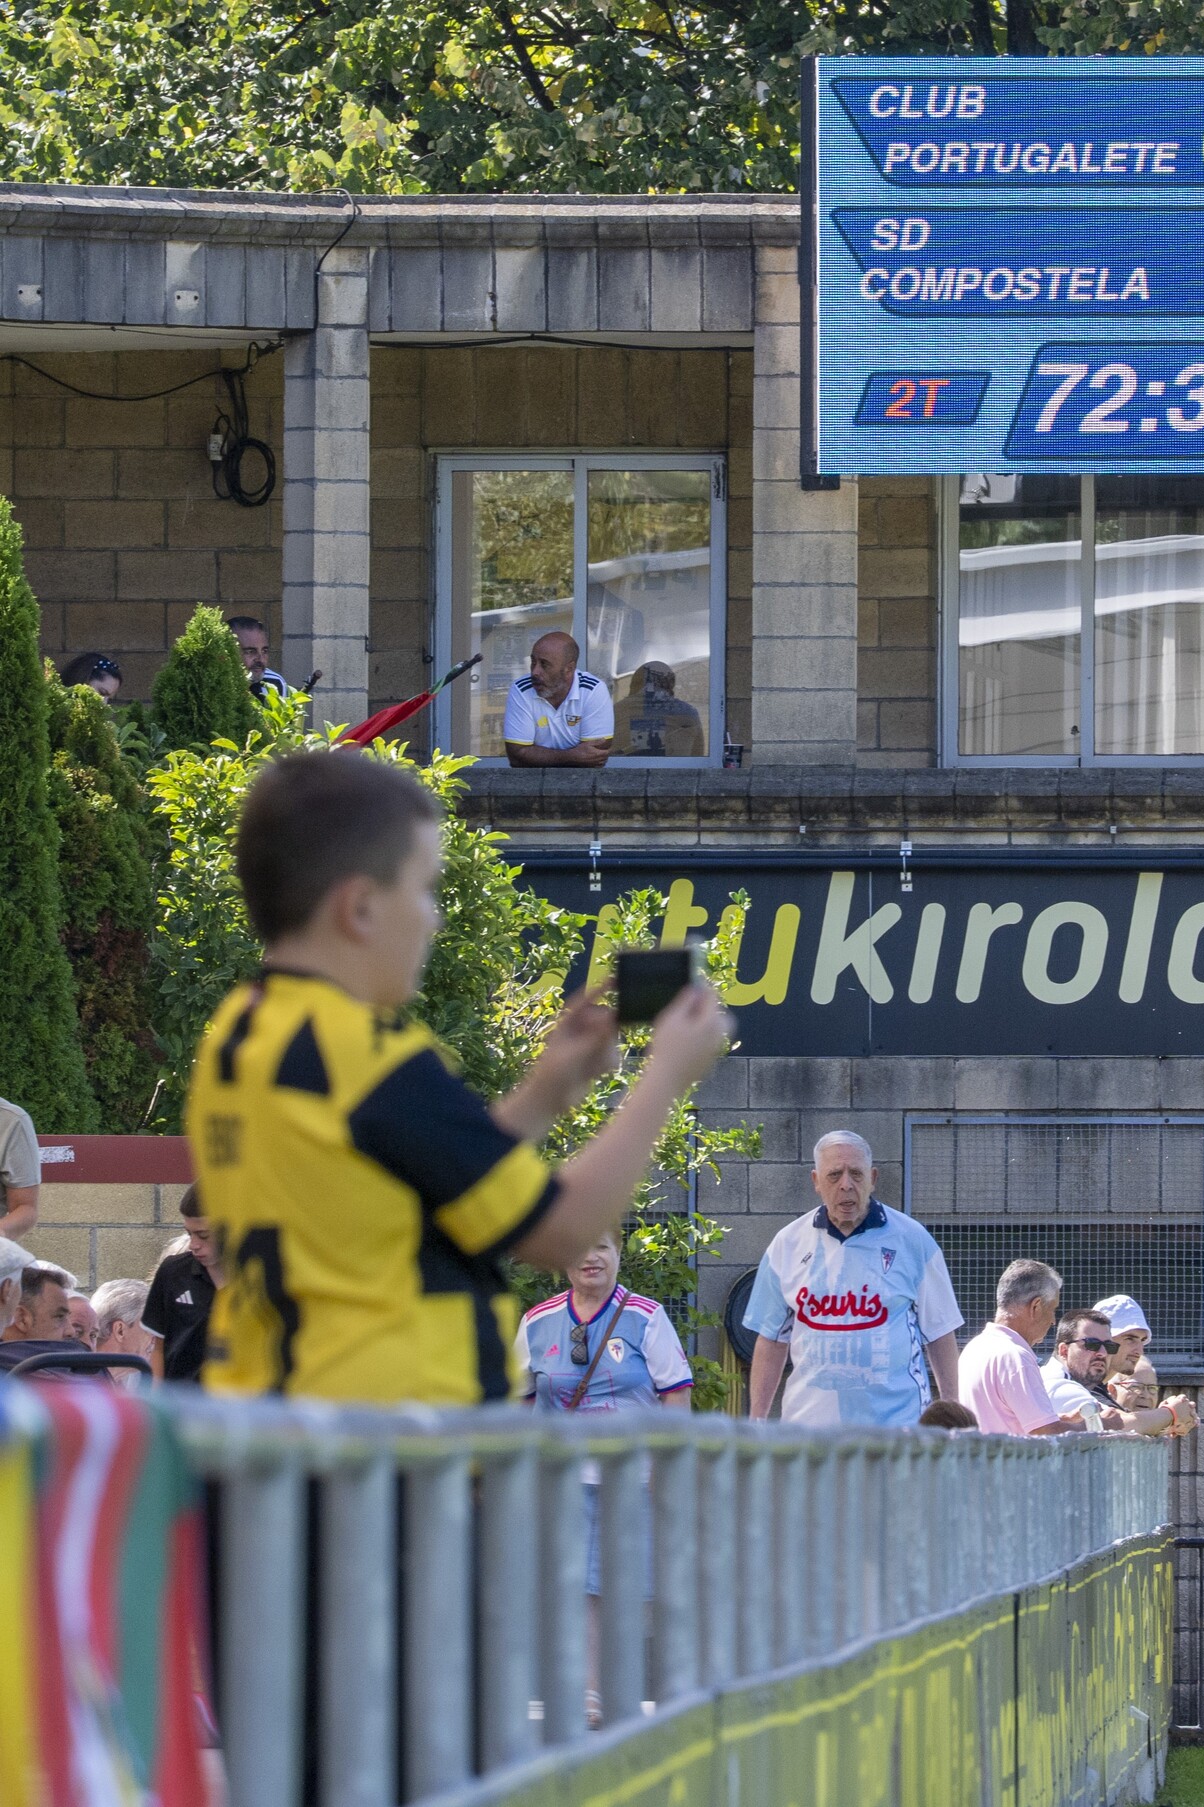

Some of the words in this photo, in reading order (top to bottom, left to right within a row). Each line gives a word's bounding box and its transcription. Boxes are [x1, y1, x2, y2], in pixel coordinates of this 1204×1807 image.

[869, 86, 986, 118] CLUB
[883, 142, 1180, 173] PORTUGALETE
[871, 219, 931, 251] SD
[860, 268, 1150, 301] COMPOSTELA
[884, 379, 950, 418] 2T
[796, 1284, 888, 1331] Escuris
